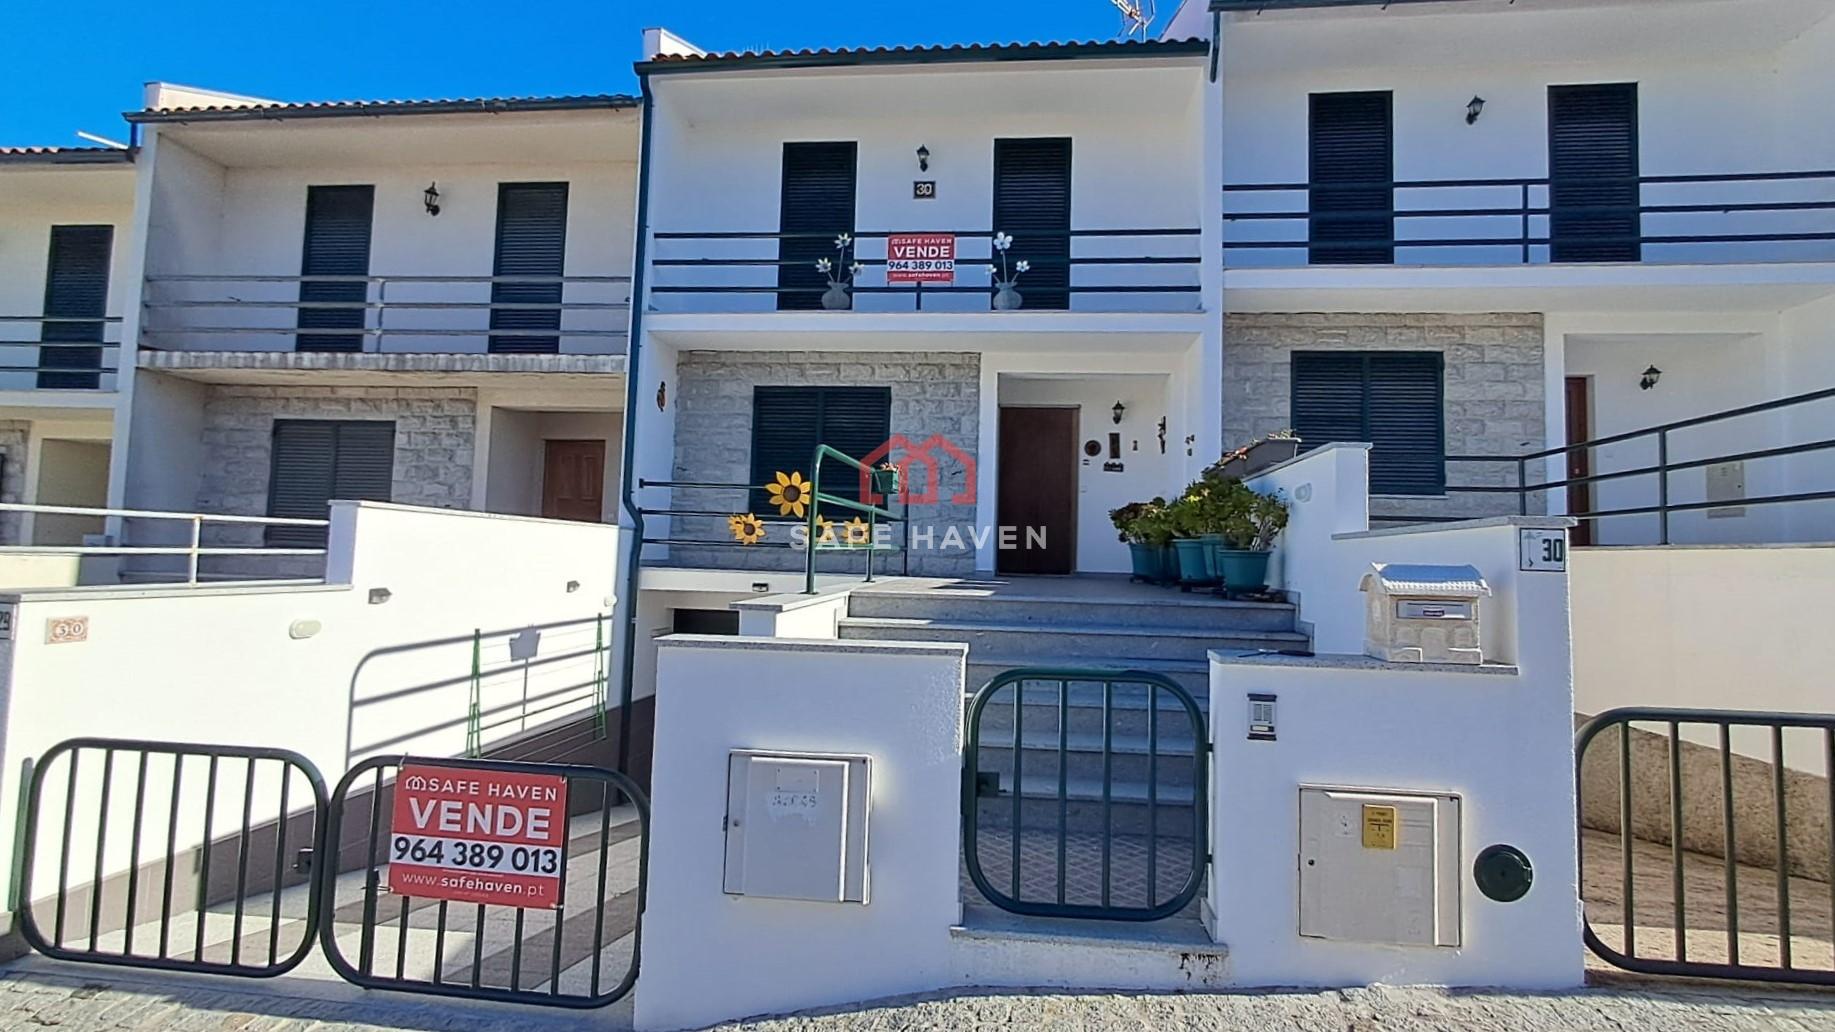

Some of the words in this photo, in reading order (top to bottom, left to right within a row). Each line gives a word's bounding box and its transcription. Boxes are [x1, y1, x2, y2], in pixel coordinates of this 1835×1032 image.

[916, 183, 932, 195] 30
[893, 246, 950, 258] VENDE
[888, 260, 909, 270] 964
[911, 260, 932, 270] 389
[934, 260, 953, 270] 013
[1541, 538, 1564, 562] 30
[58, 623, 82, 637] 30
[428, 777, 481, 796] SAFE
[487, 782, 558, 802] HAVEN
[409, 796, 551, 841] VENDE
[393, 836, 445, 865] 964
[451, 841, 504, 869] 389
[511, 846, 558, 874] 013
[401, 872, 545, 898] www.safehaven.pt
